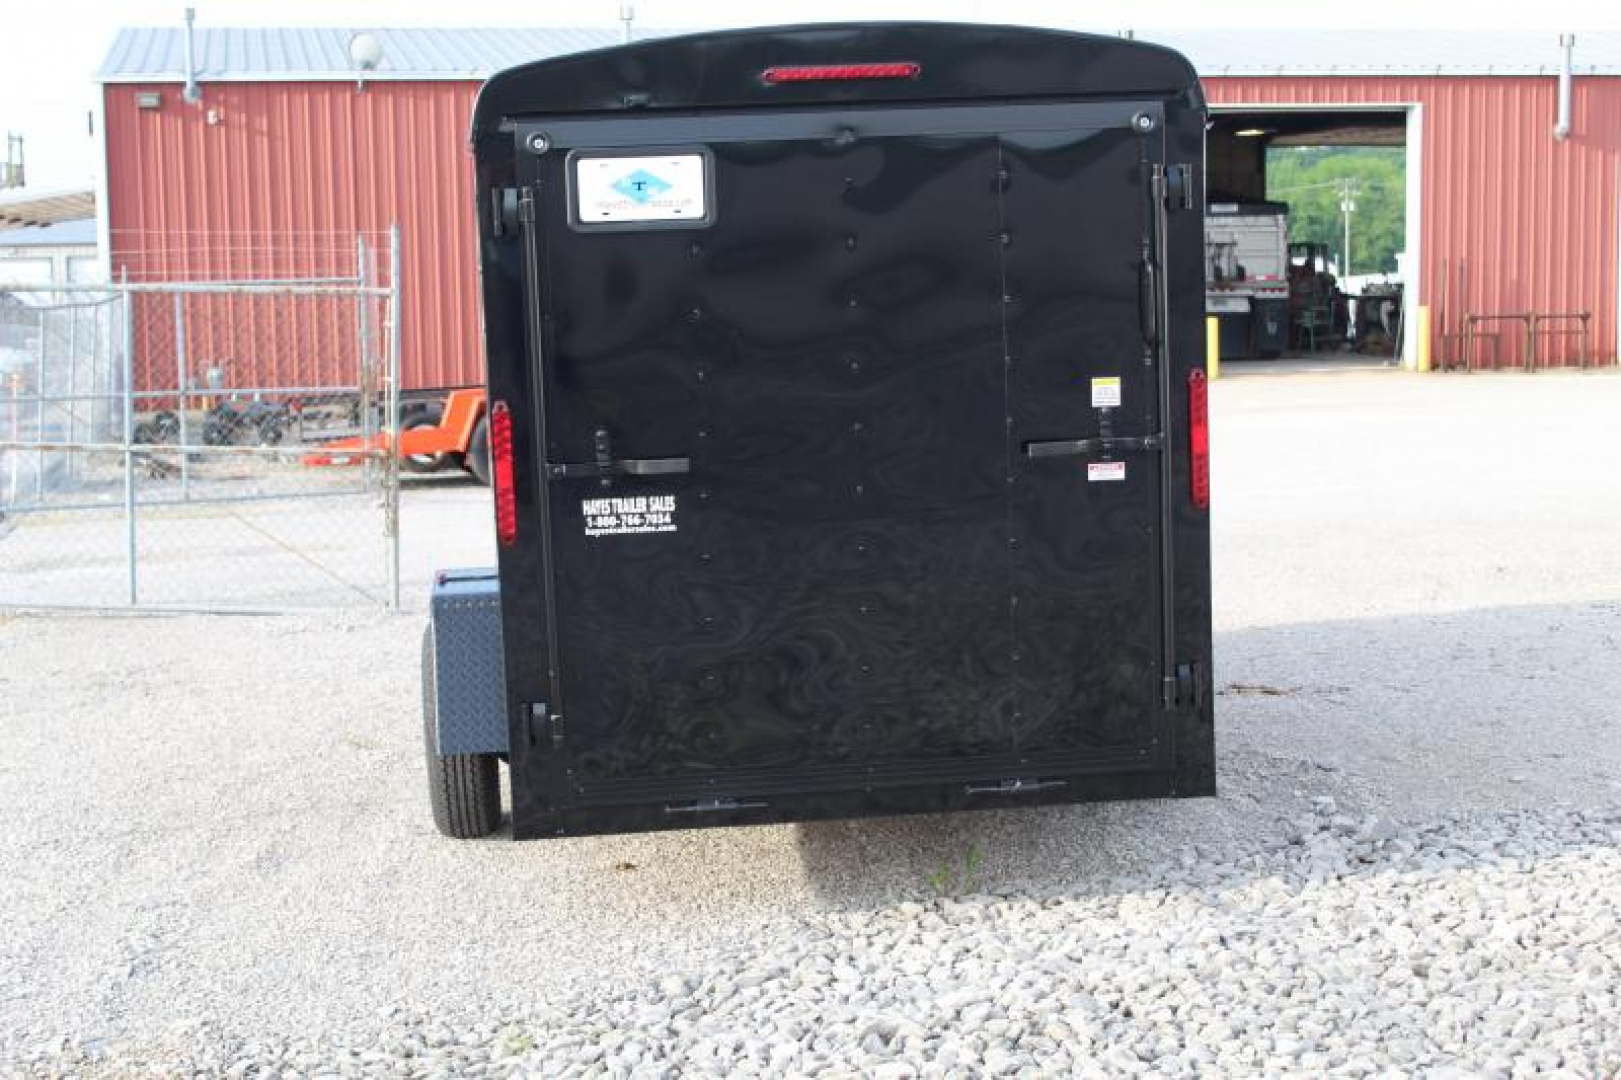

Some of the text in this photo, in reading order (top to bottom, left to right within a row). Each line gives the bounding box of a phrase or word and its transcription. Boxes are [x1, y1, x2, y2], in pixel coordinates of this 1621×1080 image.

[632, 181, 647, 191] T
[583, 495, 675, 515] HAYES TRAILER SALES
